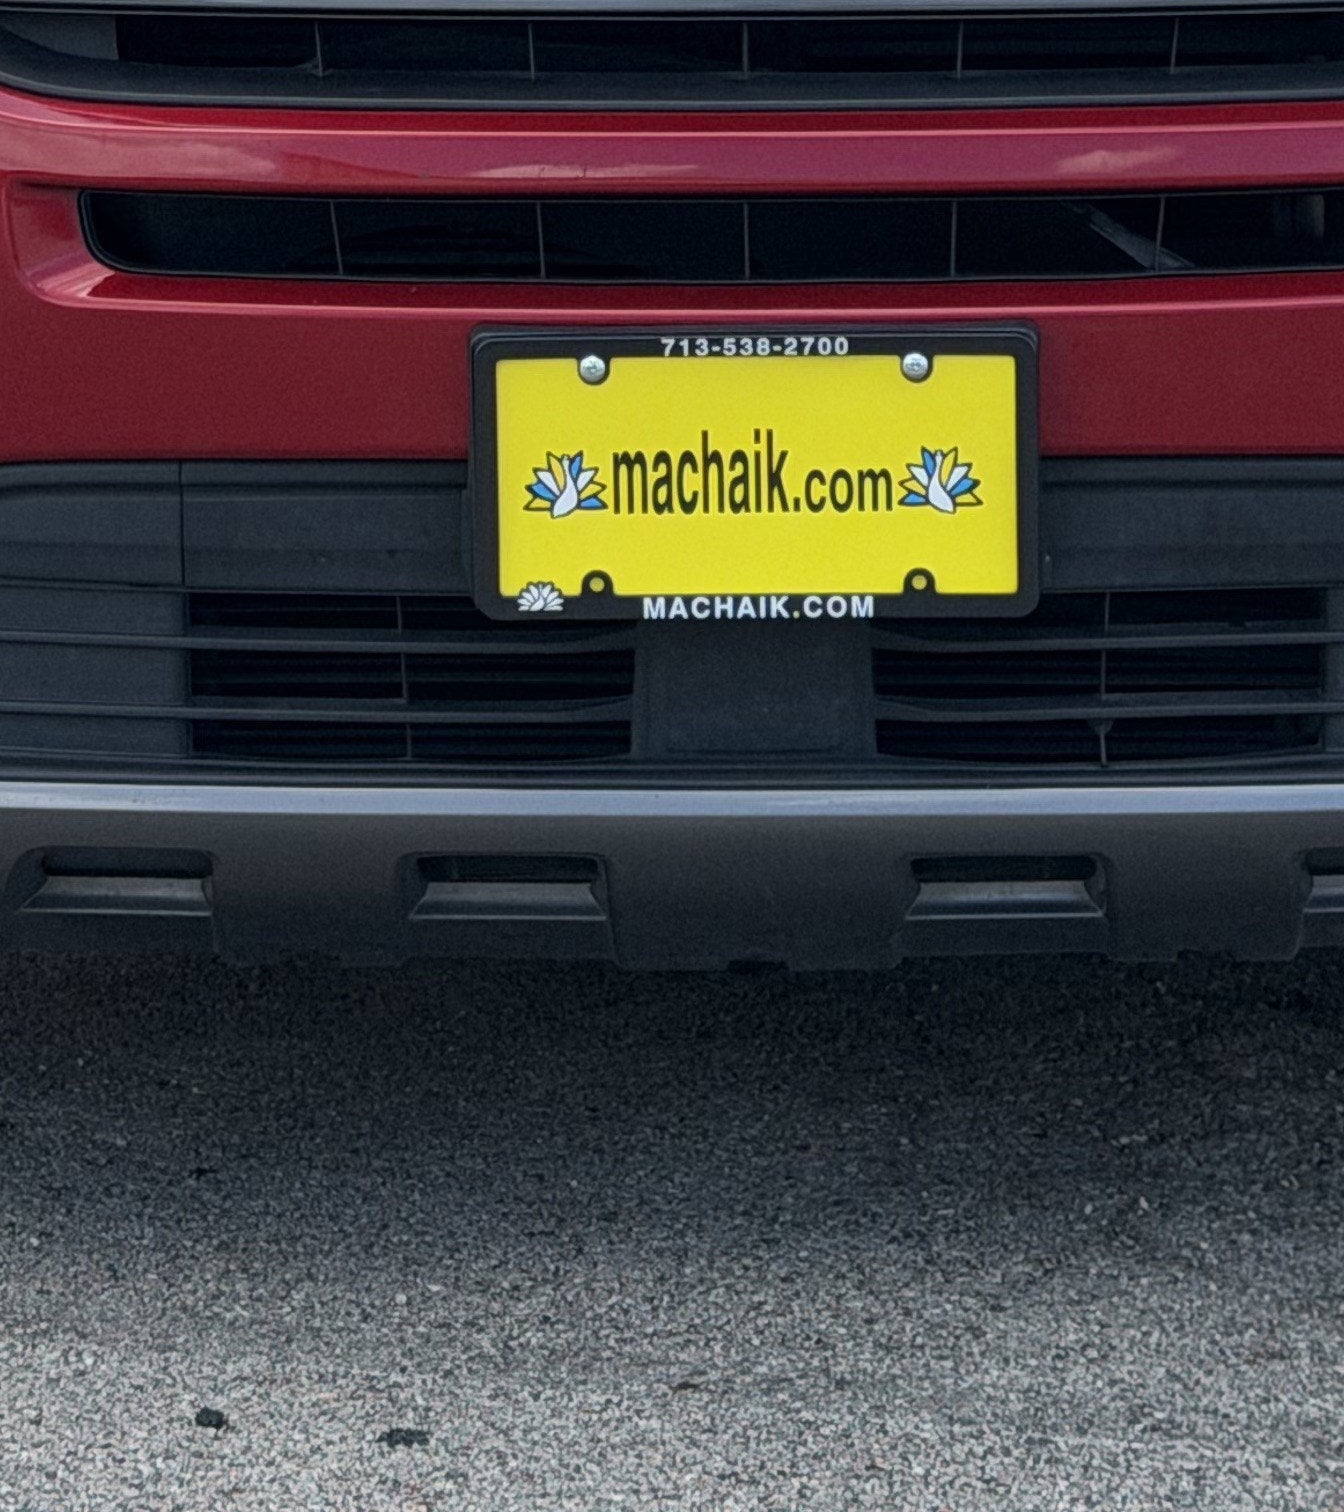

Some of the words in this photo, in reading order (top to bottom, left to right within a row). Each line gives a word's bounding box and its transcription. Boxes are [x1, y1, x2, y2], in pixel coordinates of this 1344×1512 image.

[660, 336, 850, 357] 713-538-2700
[612, 428, 894, 515] machaik.com
[642, 595, 875, 621] MACHAIK.COM
